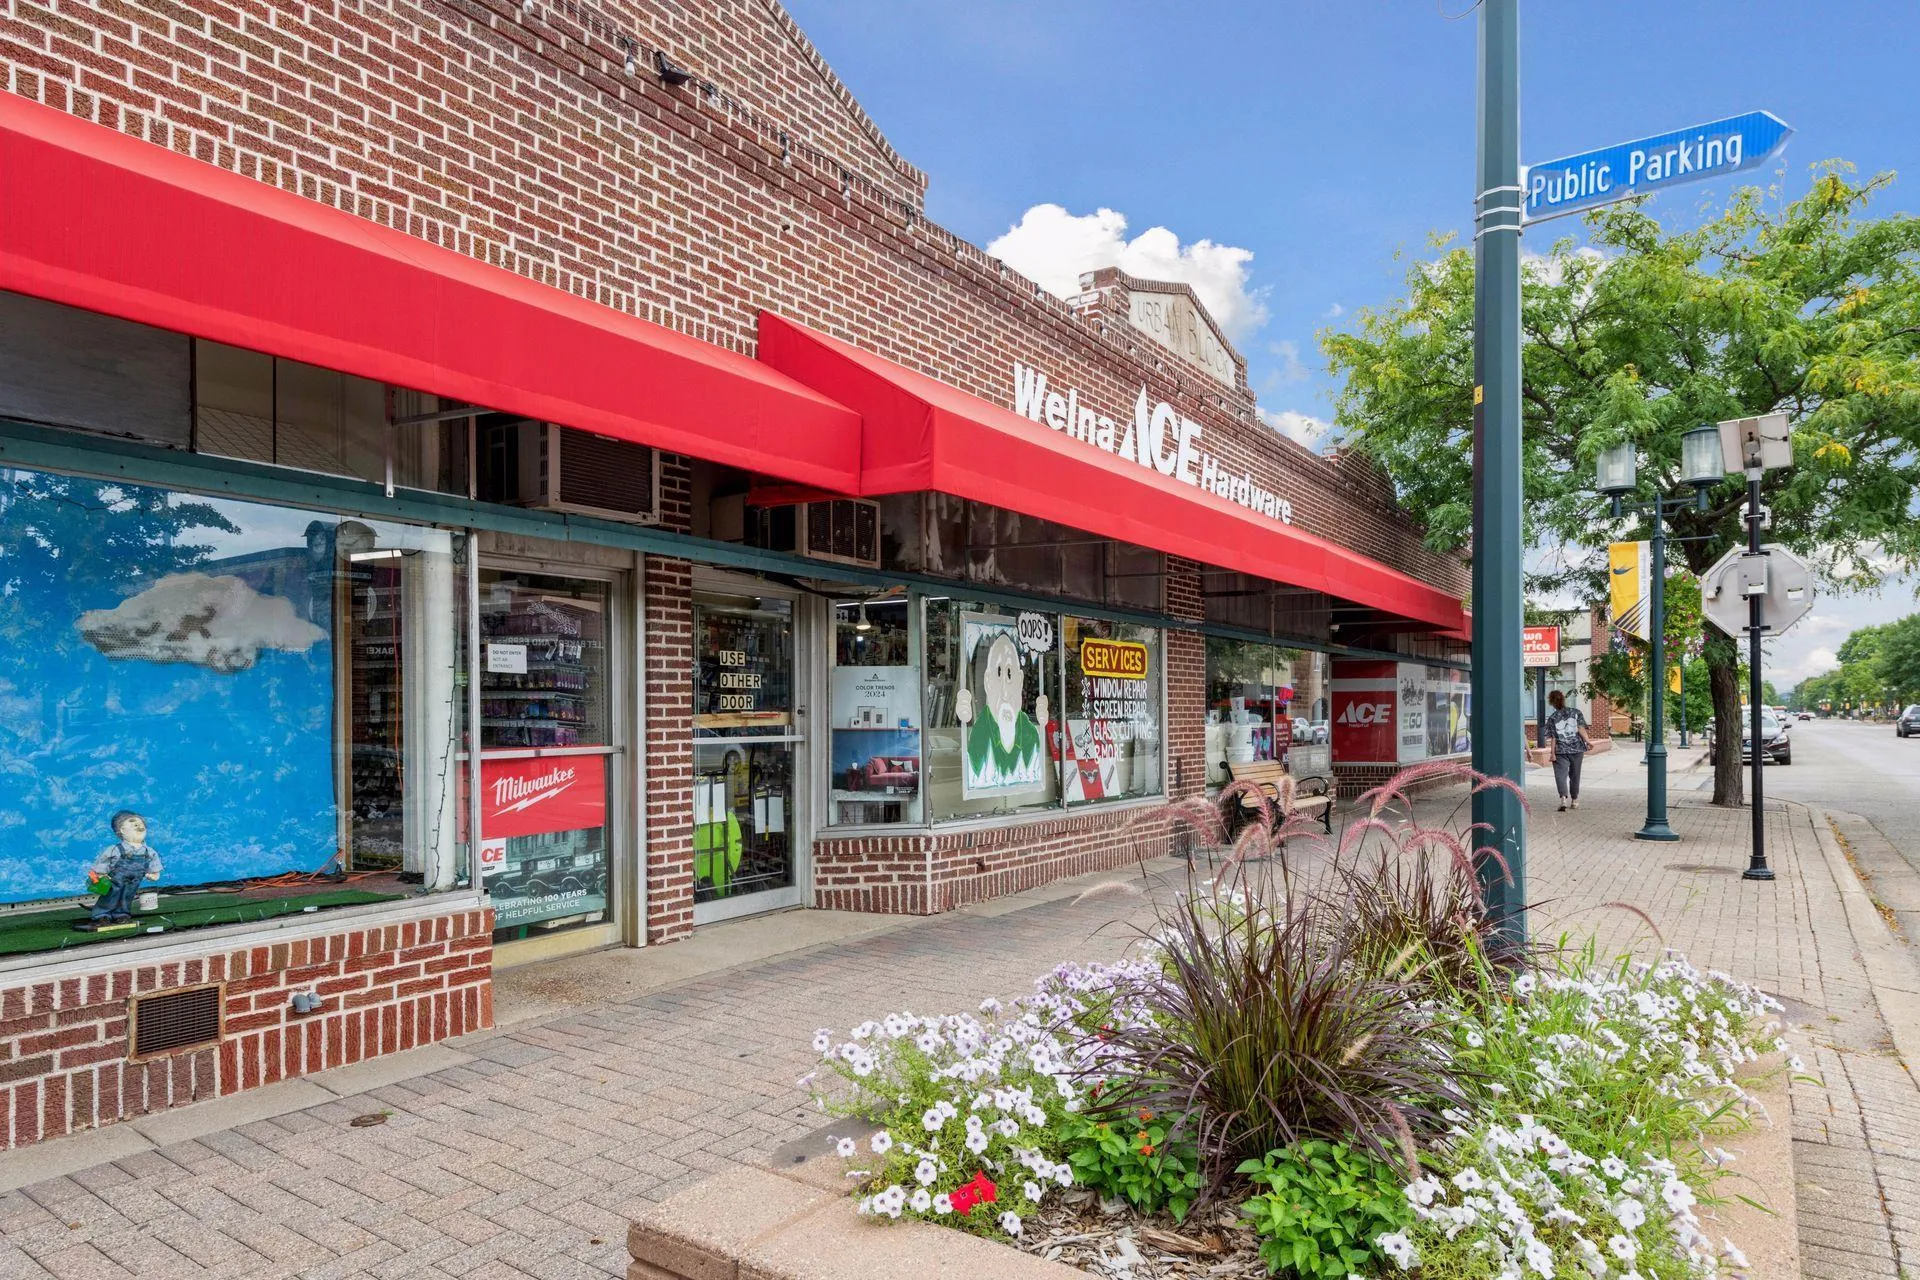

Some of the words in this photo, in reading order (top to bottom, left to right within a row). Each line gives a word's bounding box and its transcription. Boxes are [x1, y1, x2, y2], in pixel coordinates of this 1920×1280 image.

[1531, 161, 1610, 208] Public
[1629, 133, 1743, 185] Parking
[1137, 300, 1183, 347] URBAN
[1187, 309, 1231, 378] BLOCK
[1013, 361, 1116, 453] Welna
[1118, 382, 1202, 487] ACE
[1201, 453, 1292, 525] Hardware
[1020, 619, 1049, 643] OOPS!
[721, 651, 744, 665] USE
[1086, 646, 1142, 672] SERVICES
[721, 674, 760, 687] OTHER
[1093, 678, 1123, 699] WINDOW
[1123, 679, 1148, 699] REPAIR
[721, 696, 753, 709] DOOR
[1093, 700, 1123, 719] SCREEN
[1123, 701, 1147, 719] REPAIR
[1336, 700, 1392, 723] ACE
[1093, 721, 1117, 741] GLASS
[1118, 720, 1152, 740] CUTTING
[1102, 743, 1124, 762] MORE
[490, 767, 575, 806] Milwaukee
[481, 847, 504, 863] CE
[544, 894, 559, 903] 100
[560, 888, 587, 900] YEARS
[506, 907, 544, 919] HELPFUL
[546, 899, 580, 912] SERVICE
